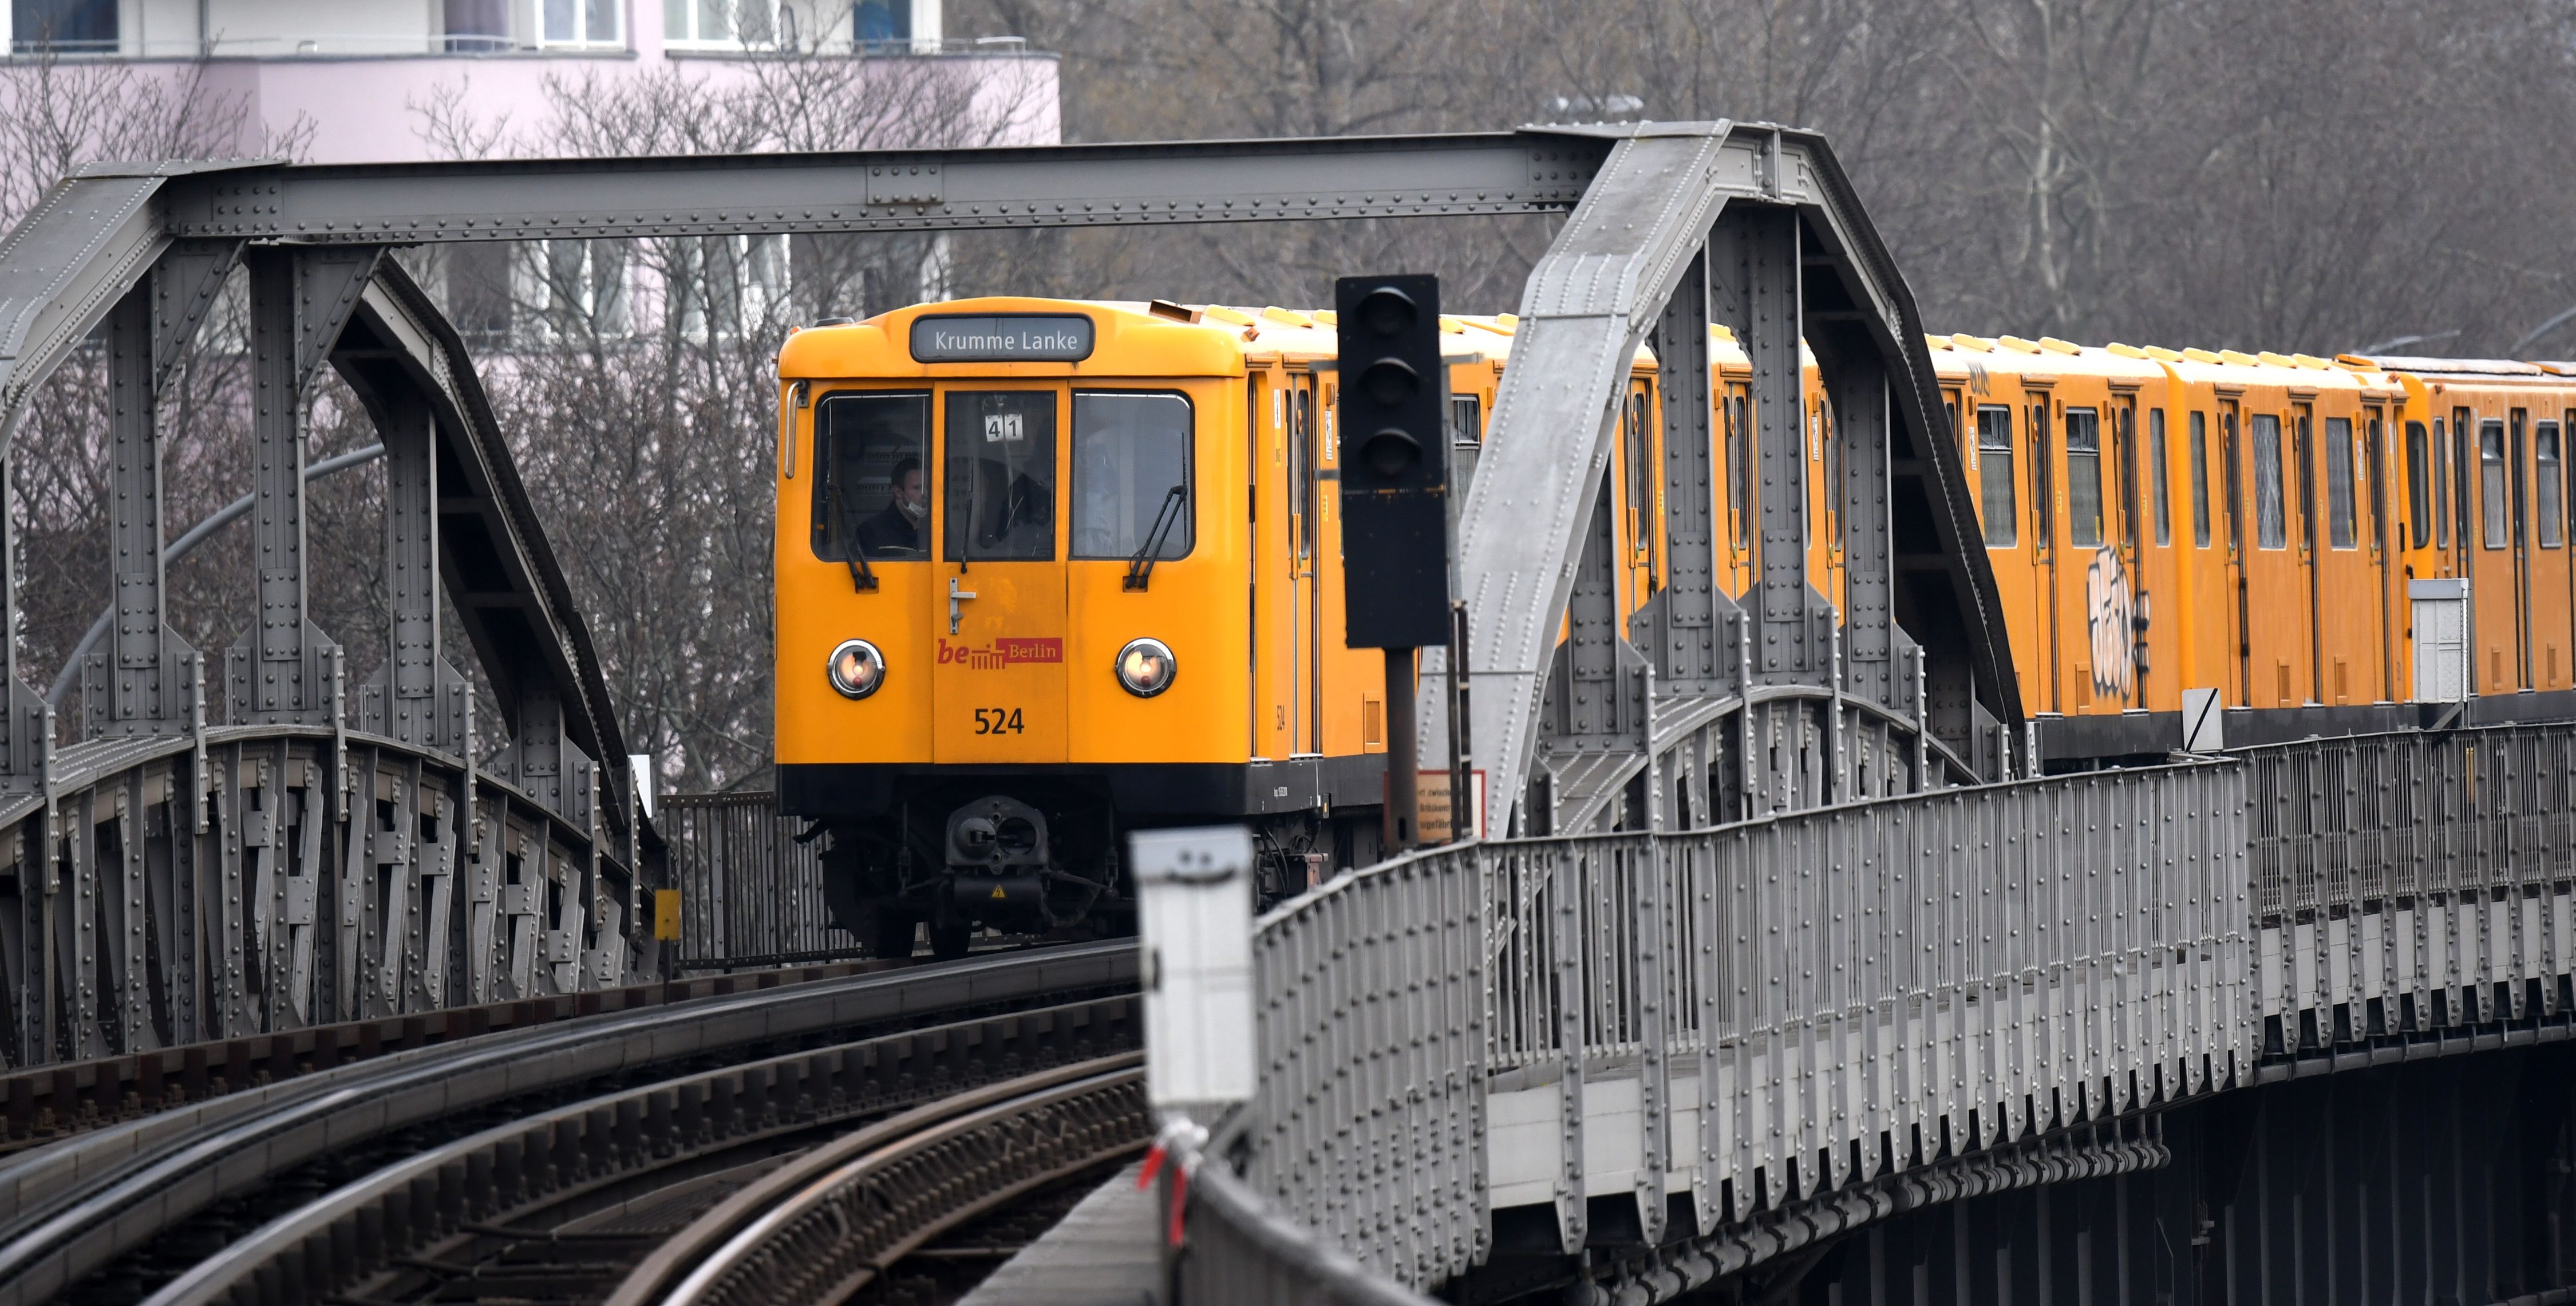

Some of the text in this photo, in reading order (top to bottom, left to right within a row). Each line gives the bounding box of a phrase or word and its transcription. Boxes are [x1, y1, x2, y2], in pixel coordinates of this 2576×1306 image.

[935, 330, 1078, 350] Krumme Lanke
[938, 638, 1056, 664] be Berlin
[974, 708, 1025, 735] 524
[1277, 705, 1285, 731] 524
